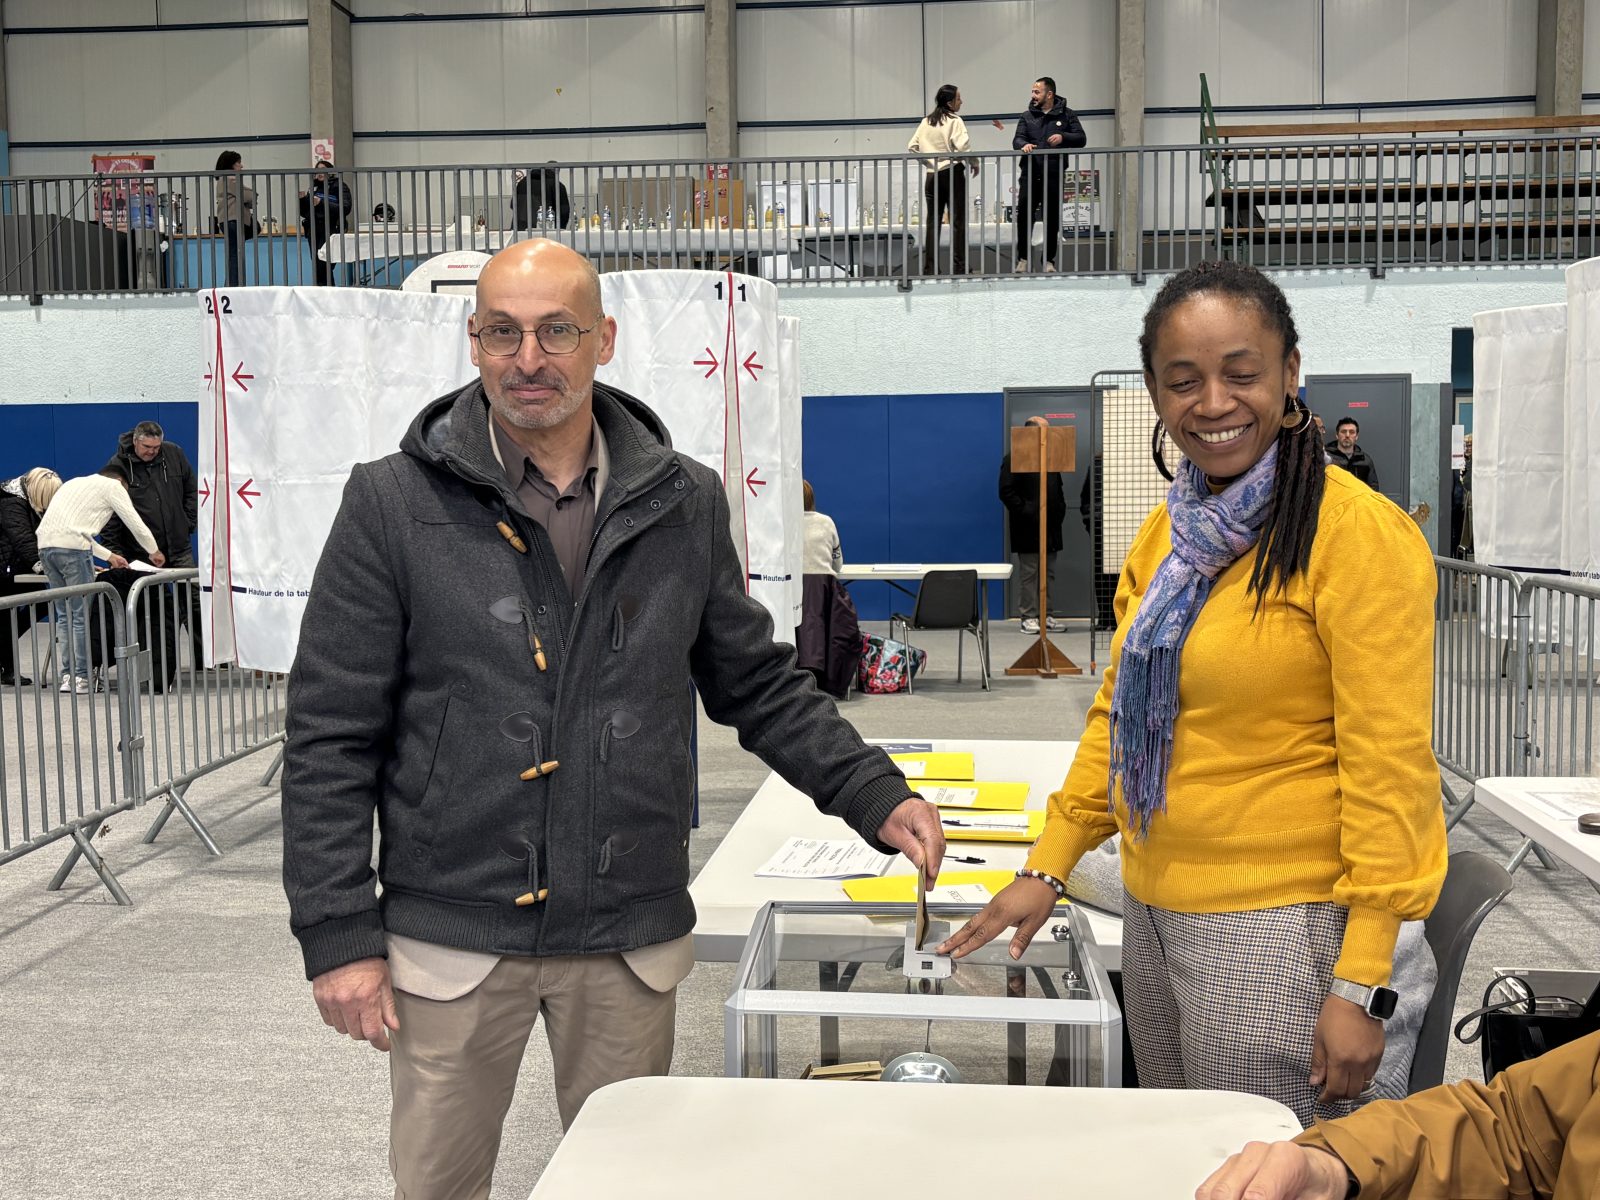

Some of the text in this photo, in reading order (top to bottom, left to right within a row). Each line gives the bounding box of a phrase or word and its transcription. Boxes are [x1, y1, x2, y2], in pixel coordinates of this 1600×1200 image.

[714, 281, 722, 300] 1
[738, 283, 746, 302] 1
[205, 296, 213, 314] 2
[221, 296, 232, 314] 2
[248, 588, 272, 597] Hauteur
